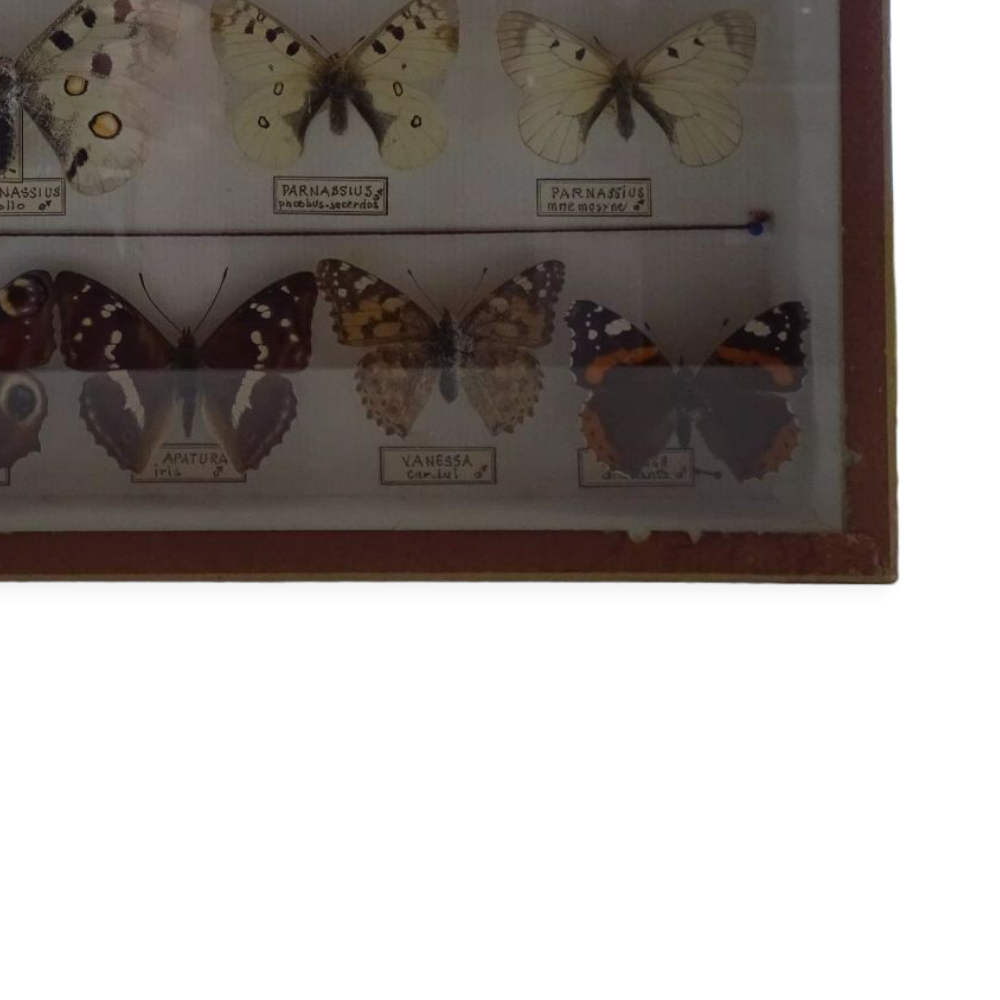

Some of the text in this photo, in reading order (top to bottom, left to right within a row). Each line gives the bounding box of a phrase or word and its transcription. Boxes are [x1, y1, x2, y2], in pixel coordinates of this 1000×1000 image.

[281, 184, 373, 197] PARNASSIUS
[162, 451, 228, 465] APATURA
[401, 453, 473, 468] VANESSA
